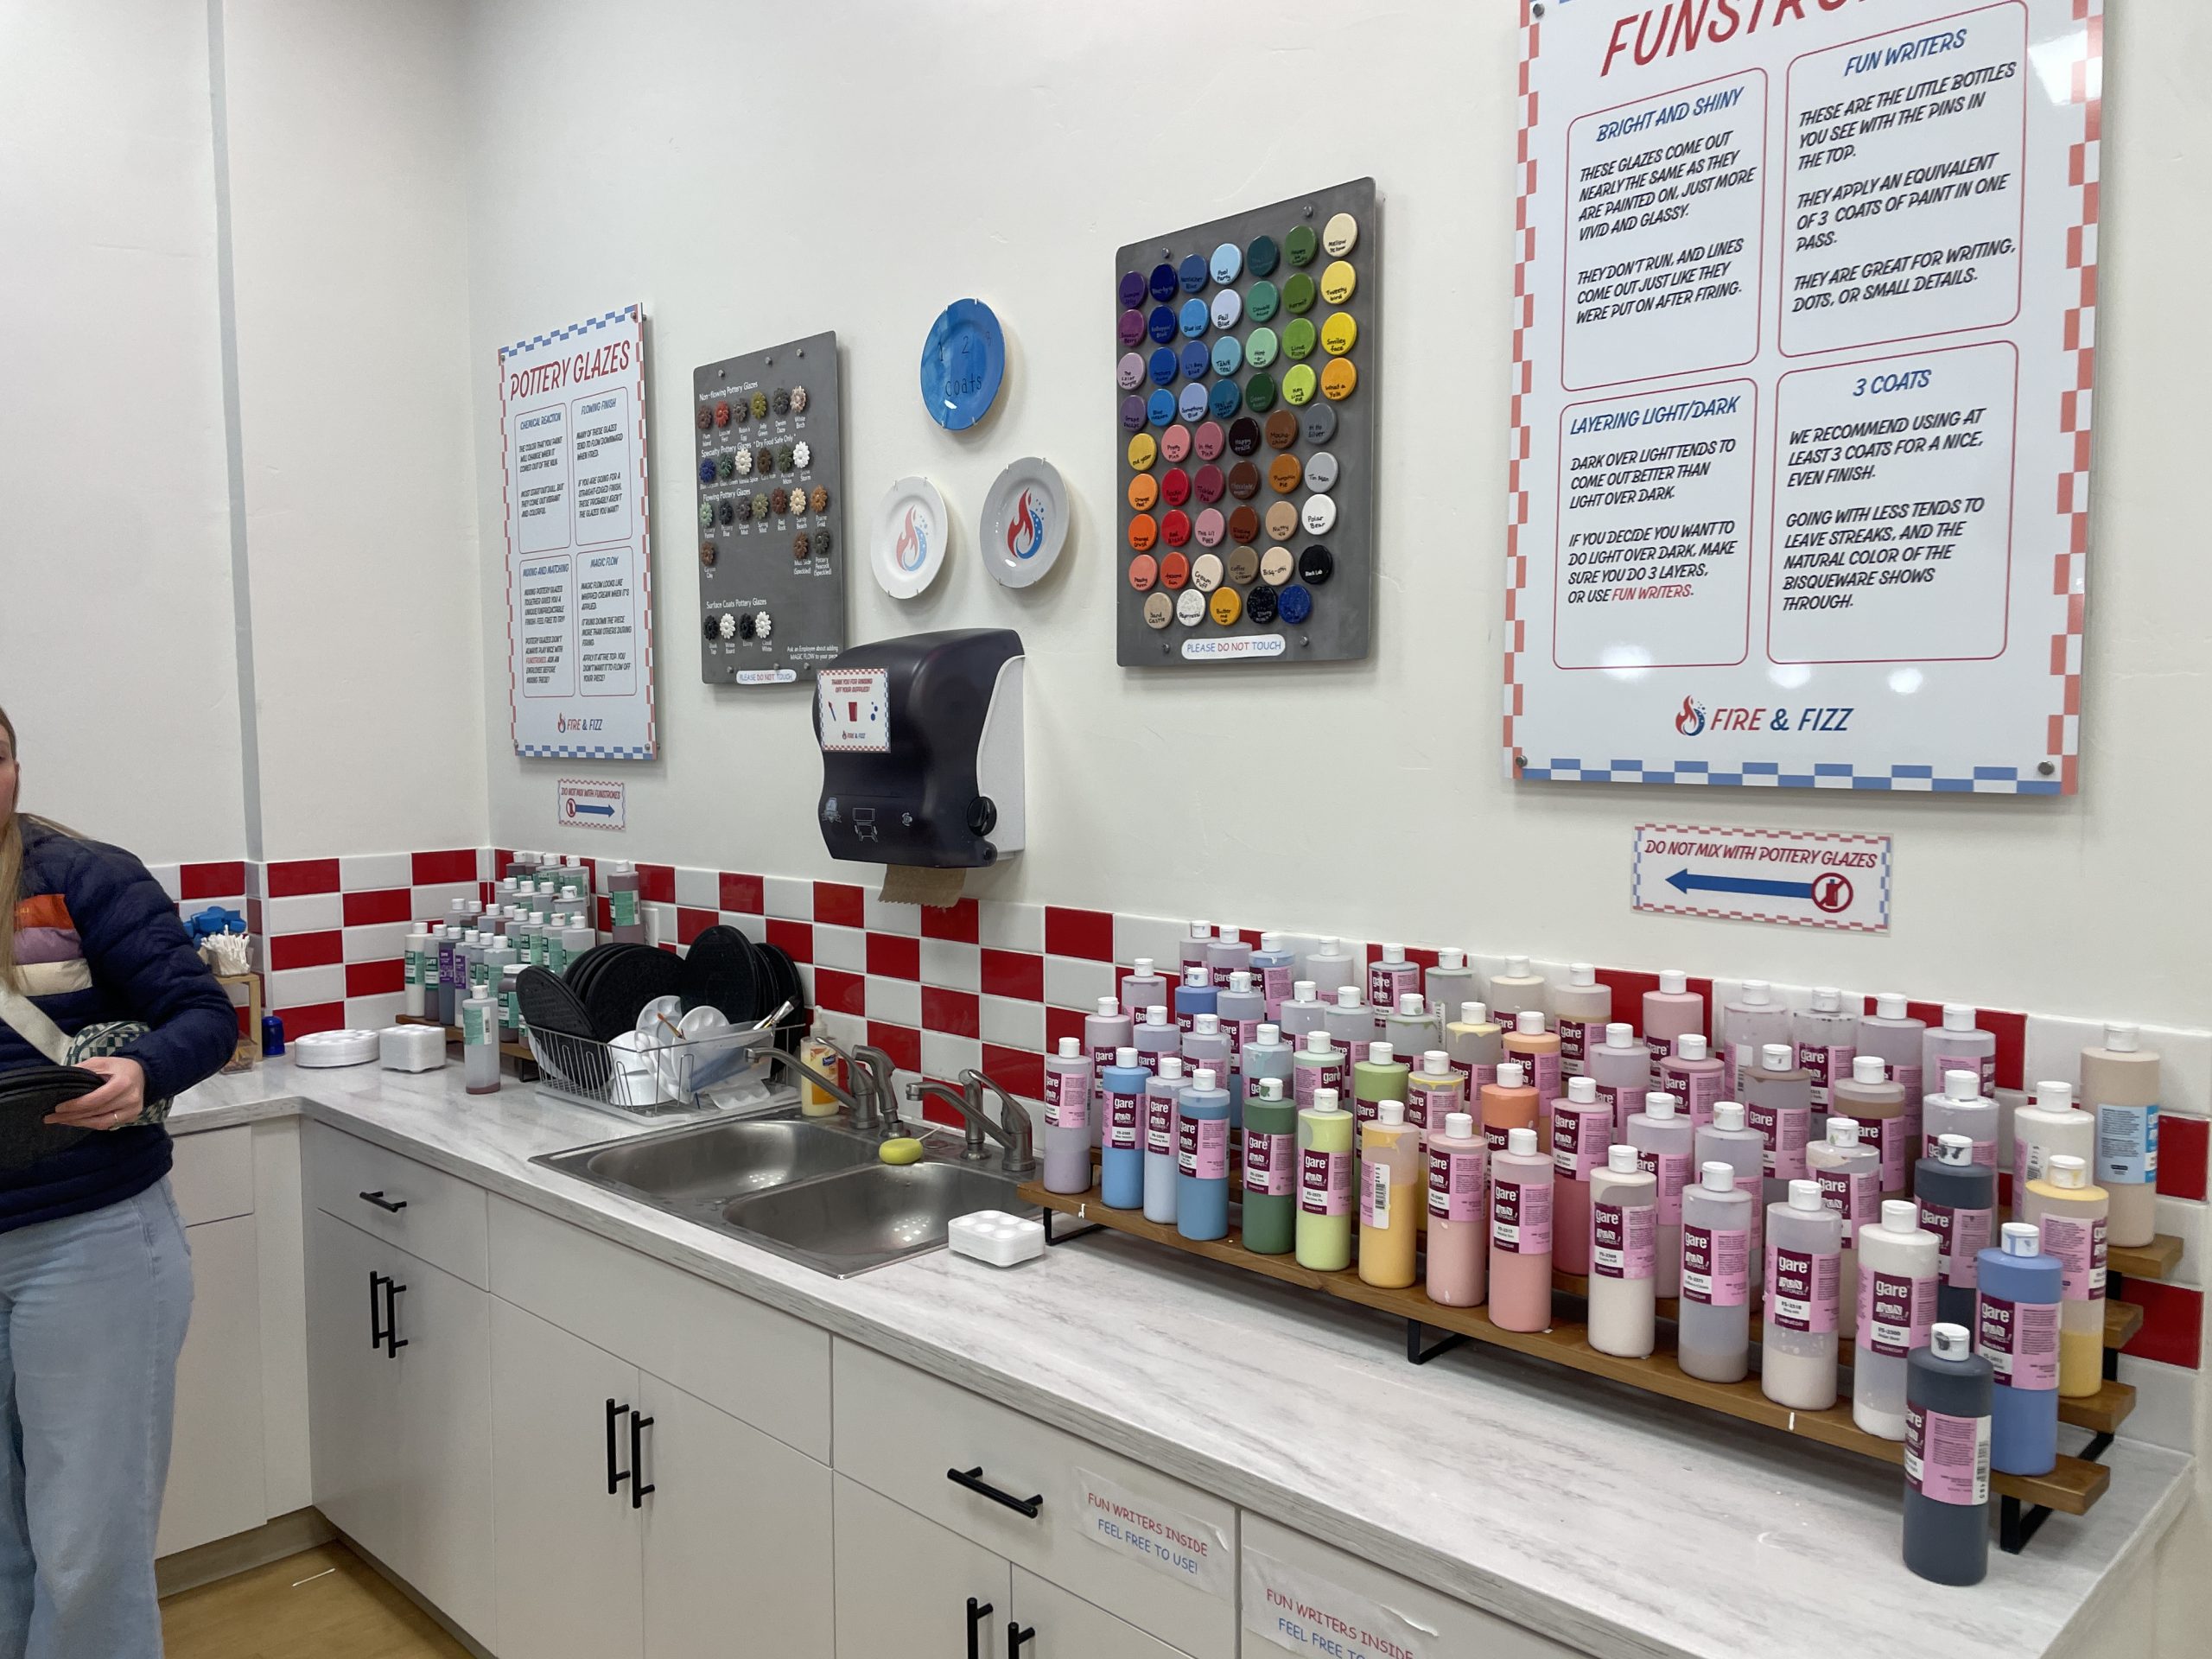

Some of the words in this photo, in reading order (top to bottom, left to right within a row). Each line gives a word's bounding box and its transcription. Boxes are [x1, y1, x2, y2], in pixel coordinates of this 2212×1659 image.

[1844, 50, 1883, 77] FUN
[1885, 29, 1967, 67] WRITERS
[1799, 102, 1845, 127] THESE
[1843, 94, 1877, 117] ARE
[1877, 87, 1906, 109] THE
[1905, 76, 1951, 102] LITTLE
[1950, 61, 2017, 91] BOTTLES
[1596, 110, 1657, 142] BRIGHT
[1655, 102, 1690, 127] AND
[1693, 86, 1745, 116] SHINY
[1799, 128, 1829, 149] YOU
[1829, 121, 1859, 141] SEE
[1859, 111, 1897, 135] WITH
[1897, 105, 1928, 126] THE
[1928, 96, 1966, 118] PINS
[1967, 92, 1986, 110] IN
[1580, 160, 1618, 182] THESE
[1618, 149, 1663, 172] GLAZES
[1665, 137, 1705, 161] COME
[1705, 130, 1734, 150] OUT
[1798, 150, 1826, 170] THE
[1826, 144, 1856, 164] TOP.
[1579, 178, 1627, 202] NEARLY
[1624, 172, 1649, 191] THE
[1649, 162, 1687, 185] SAME
[1686, 158, 1706, 176] AS
[1707, 149, 1741, 171] THEY
[962, 335, 969, 354] 2
[511, 357, 571, 401] POTTERY
[573, 340, 631, 383] GLAZES
[727, 385, 743, 395] Pottery
[743, 381, 759, 391] Glazes
[1853, 378, 1867, 397] 3
[1871, 369, 1932, 394] COATS
[601, 397, 617, 410] FINISH
[1570, 410, 1640, 435] LAYERING
[1642, 396, 1741, 425] LIGHT/DARK
[1789, 429, 1813, 445] WE
[1812, 417, 1910, 442] RECOMMEND
[1912, 411, 1961, 431] USING
[1962, 407, 1987, 425] AT
[1570, 454, 1605, 471] DARK
[1605, 450, 1638, 467] OVER
[1638, 445, 1677, 463] LIGHT
[1676, 441, 1718, 459] TENDS
[1719, 438, 1736, 454] TO
[1787, 448, 1834, 467] LEAST
[1830, 447, 1842, 461] 3
[1845, 441, 1893, 460] COATS
[1893, 437, 1927, 454] FOR
[1928, 435, 1941, 451] A
[1942, 430, 1983, 450] NICE,
[1571, 474, 1607, 490] COME
[1606, 470, 1633, 486] OUT
[1630, 466, 1675, 483] BETTER
[1676, 461, 1712, 479] THAN
[1787, 470, 1825, 487] EVEN
[1824, 464, 1876, 484] FINISH.
[1569, 493, 1605, 509] LIGHT
[1605, 489, 1637, 505] OVER
[1637, 486, 1675, 502] DARK.
[590, 557, 606, 569] MAGIC
[606, 556, 619, 567] FLOW
[706, 601, 722, 609] Surface
[735, 599, 752, 607] Pottery
[753, 597, 767, 606] Glazes
[1187, 643, 1216, 652] PLEASE
[1217, 643, 1230, 652] DO
[1231, 642, 1250, 652] NOT
[1252, 641, 1281, 651] TOUCH
[740, 673, 756, 682] PLEASE
[567, 719, 582, 731] FIRE
[582, 719, 588, 731] &
[588, 719, 603, 731] FIZZ
[1710, 708, 1766, 731] FIRE
[1770, 708, 1789, 731] &
[1797, 708, 1855, 731] FIZZ
[1644, 840, 1666, 854] DO
[1668, 841, 1699, 855] NOT
[1697, 843, 1726, 858] MIX
[1723, 845, 1758, 861] WITH
[1758, 847, 1821, 864] POTTERY
[1821, 849, 1878, 868] GLAZES
[1560, 1027, 1581, 1039] gare
[1096, 1051, 1114, 1063] gare
[1800, 1050, 1825, 1063] gare
[1665, 1078, 1686, 1090] gare
[1115, 1098, 1134, 1109] gare
[1357, 1105, 1376, 1118] gare
[1555, 1116, 1577, 1130] gare
[1750, 1113, 1773, 1127] gare
[1249, 1138, 1268, 1150] gare
[1305, 1156, 1326, 1169] gare
[1430, 1158, 1447, 1170] gare
[1495, 1186, 1516, 1202] gare
[1596, 1210, 1619, 1225] gare
[1922, 1212, 1949, 1229] gare
[1685, 1232, 1707, 1249] gare
[1779, 1256, 1808, 1274] gare
[1876, 1281, 1908, 1298] gare
[1982, 1303, 2010, 1323] gare
[1088, 1492, 1110, 1512] FUN
[1112, 1503, 1163, 1535] WRITERS
[1165, 1526, 1208, 1557] INSIDE
[1098, 1518, 1122, 1540] FEEL
[1125, 1530, 1151, 1553] FREE
[1154, 1543, 1170, 1560] TO
[1267, 1588, 1293, 1611] FUN
[1296, 1601, 1357, 1640] WRITERS
[1361, 1630, 1414, 1659] INSIDE
[1279, 1618, 1307, 1643] FEEL
[1312, 1632, 1342, 1659] FREE
